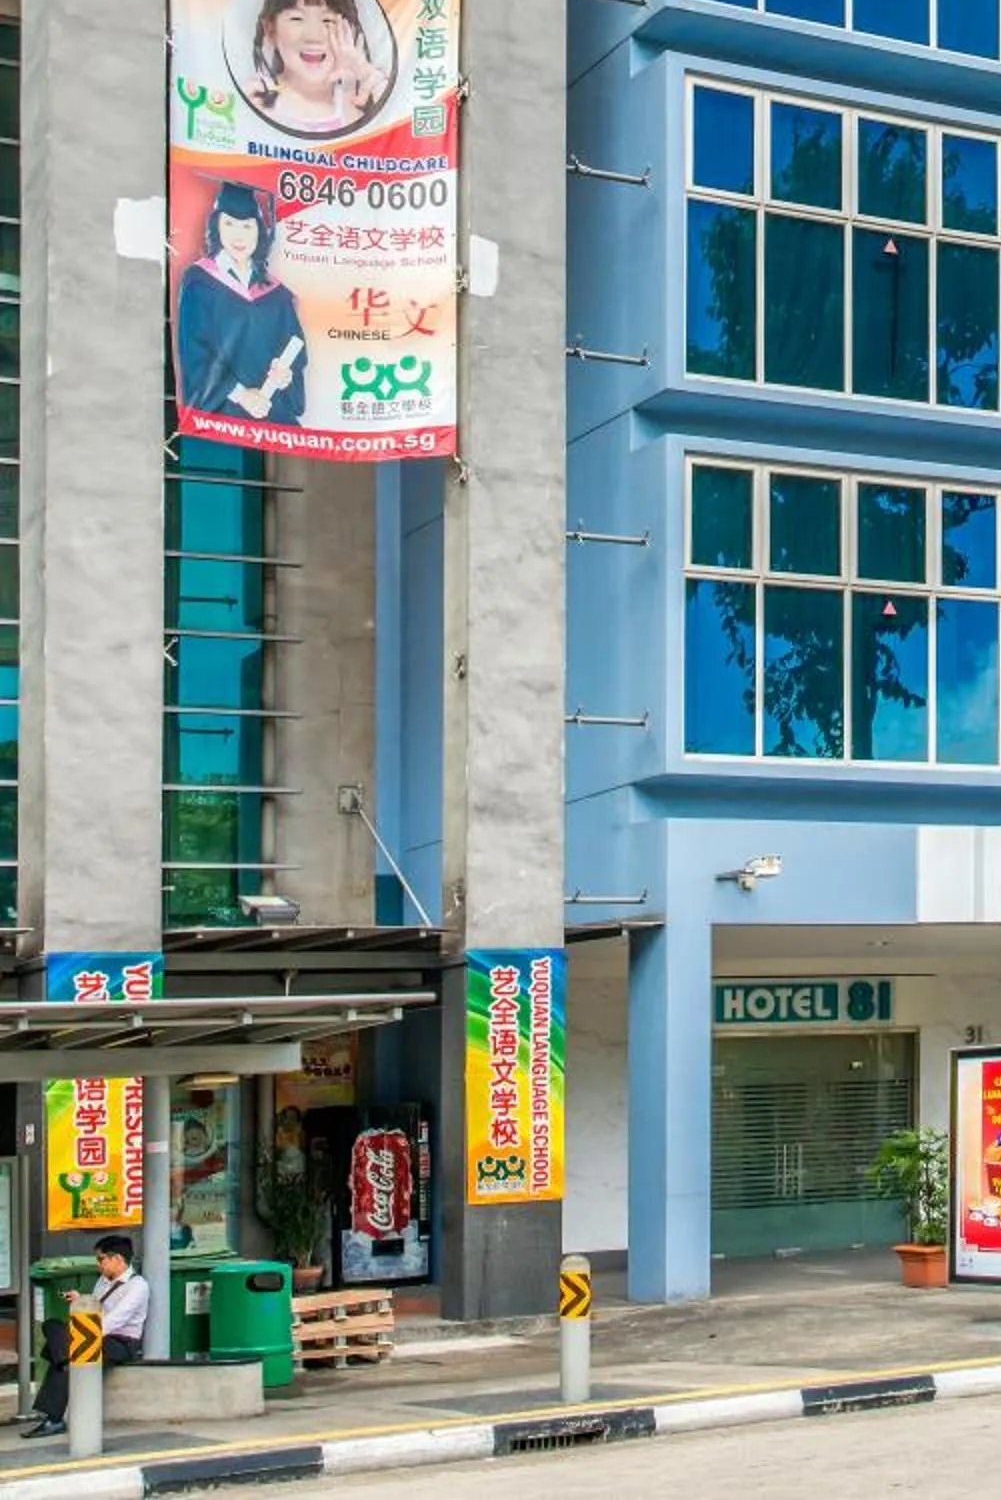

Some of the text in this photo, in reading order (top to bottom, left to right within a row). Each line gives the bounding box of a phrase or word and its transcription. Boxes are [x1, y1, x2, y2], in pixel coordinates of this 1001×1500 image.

[247, 141, 449, 173] BILINGUAL CHILDCARE
[278, 171, 449, 210] 6846 0600
[284, 219, 446, 251] 艺全语文学校
[283, 248, 448, 269] Yuquan Language School
[327, 327, 391, 341] CHINESE
[192, 415, 436, 452] www.yuquan.com.sg
[722, 980, 892, 1022] HOTEL 81
[964, 1026, 984, 1044] 31
[490, 966, 519, 1147] 艺全语文学校
[532, 959, 549, 1193] YUQUAN LANGUAGE SCHOOL
[123, 1077, 144, 1216] RESCHOOL
